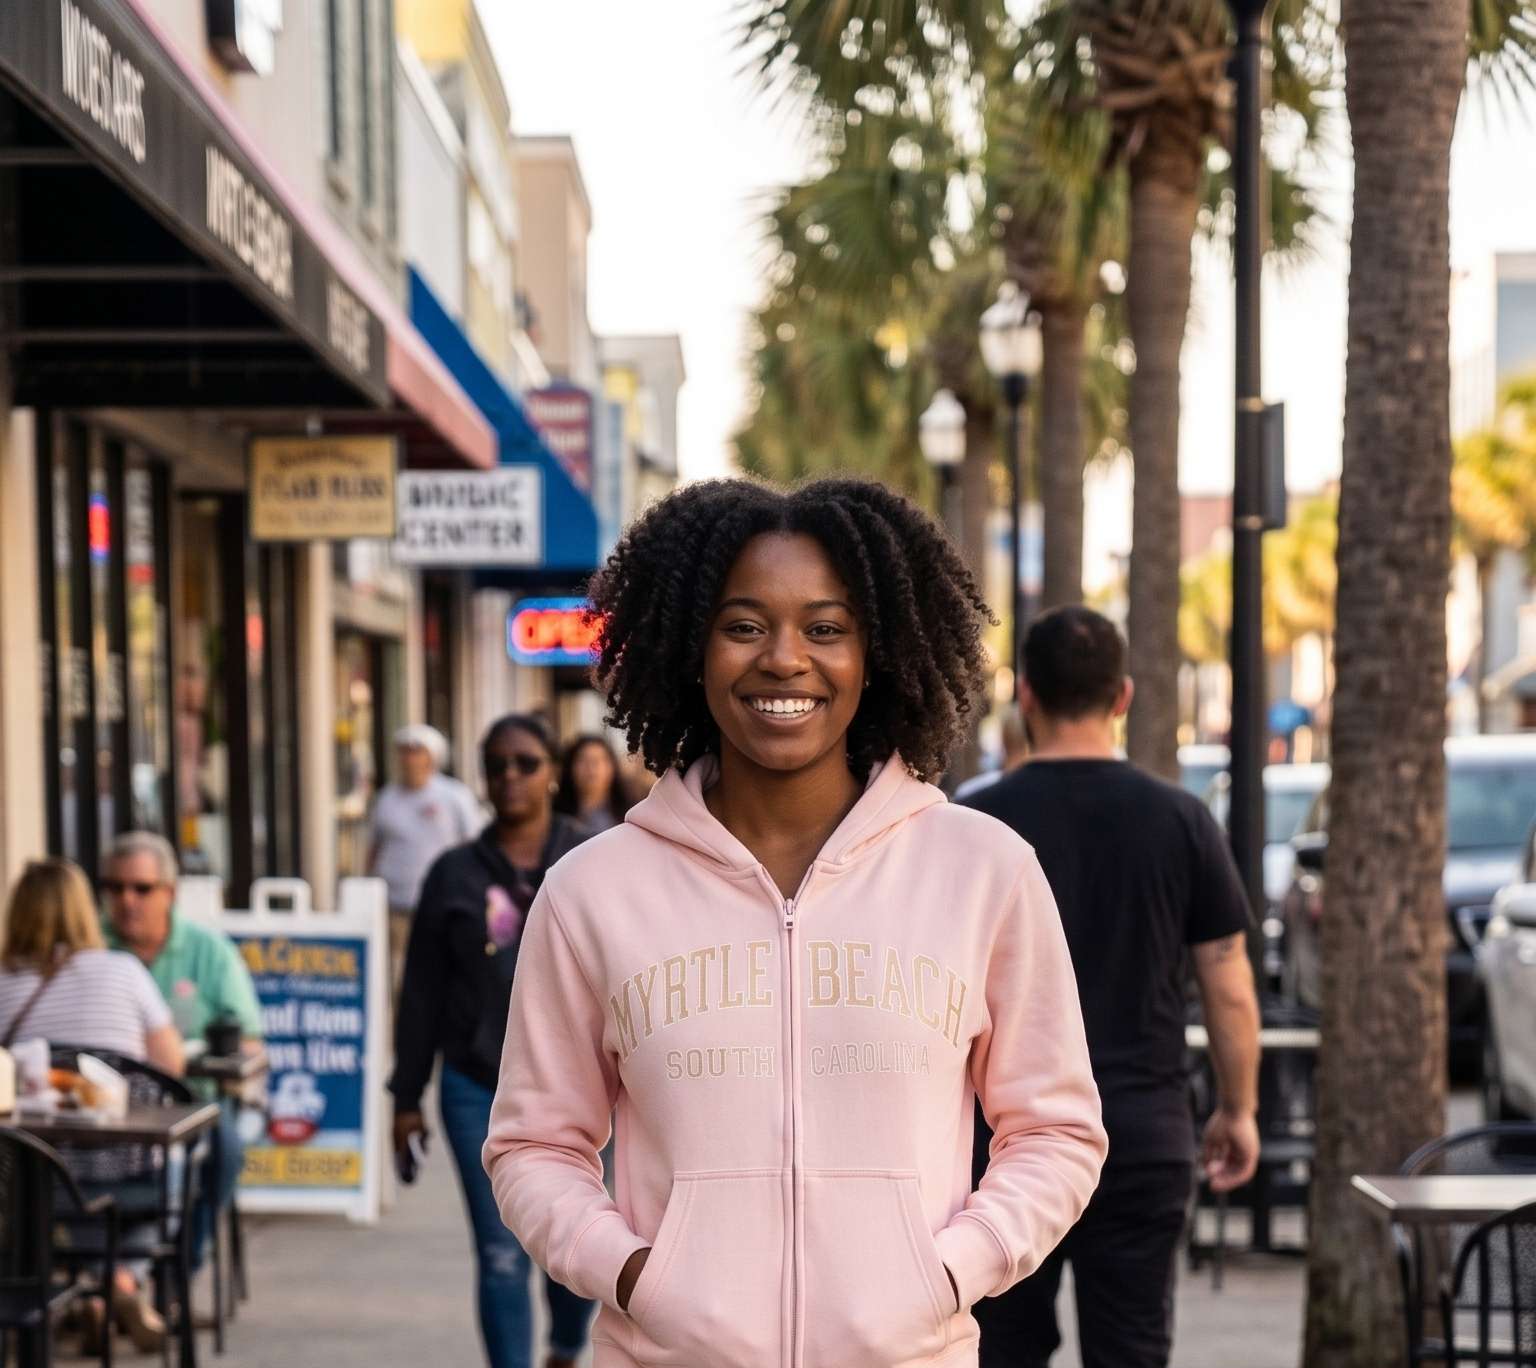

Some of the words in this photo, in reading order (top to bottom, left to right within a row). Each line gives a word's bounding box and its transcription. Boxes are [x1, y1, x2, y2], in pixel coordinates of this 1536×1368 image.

[609, 939, 774, 1063] MYRTLE
[806, 939, 968, 1050] BEACH
[666, 1046, 775, 1081] SOUTH
[810, 1041, 931, 1077] CAROLINA
